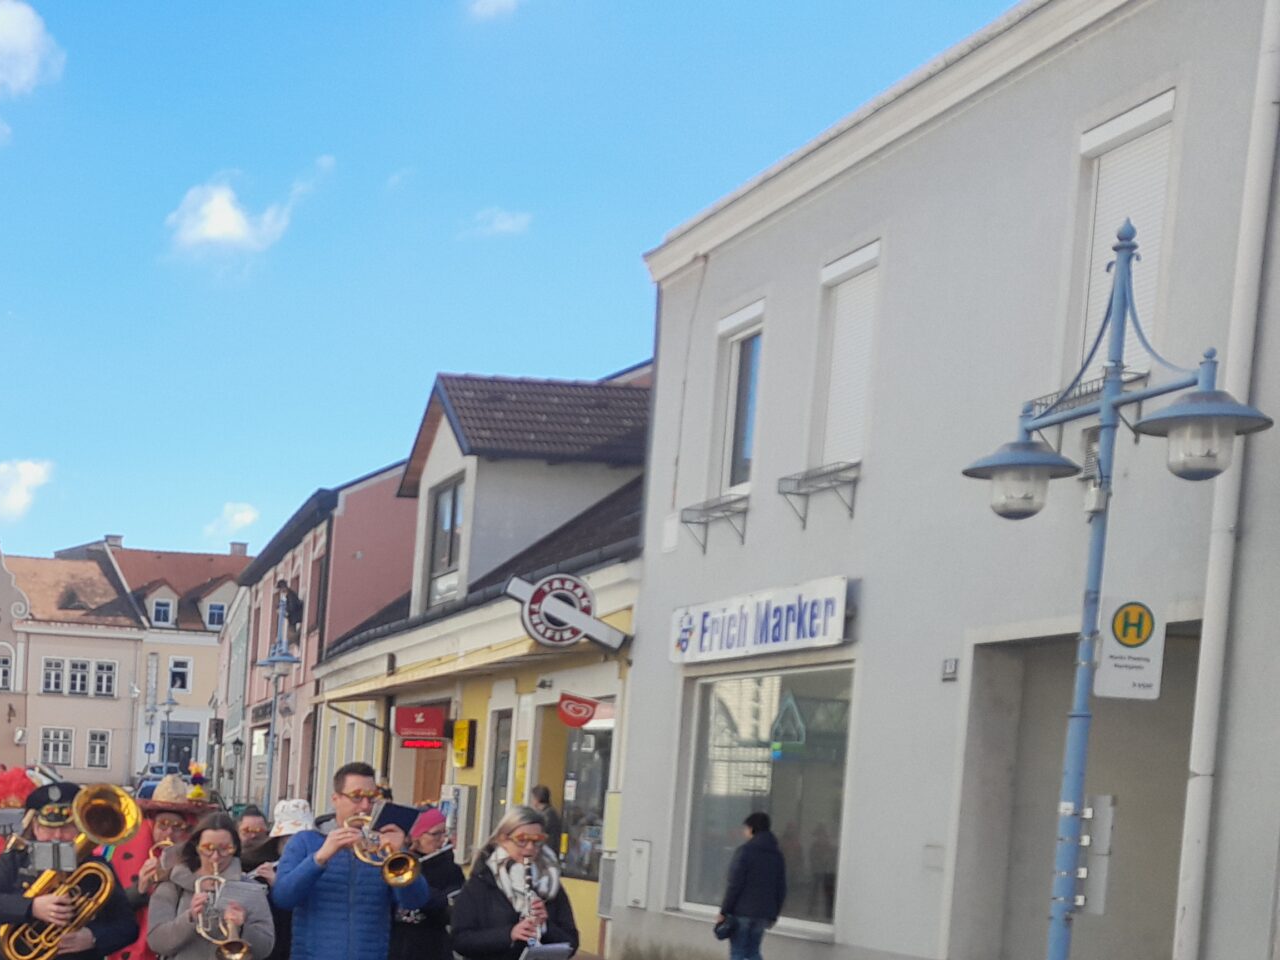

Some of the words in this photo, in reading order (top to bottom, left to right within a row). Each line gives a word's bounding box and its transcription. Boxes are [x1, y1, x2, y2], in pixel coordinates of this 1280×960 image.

[699, 604, 748, 652] Erich
[753, 594, 837, 645] Marker
[1122, 611, 1144, 638] H
